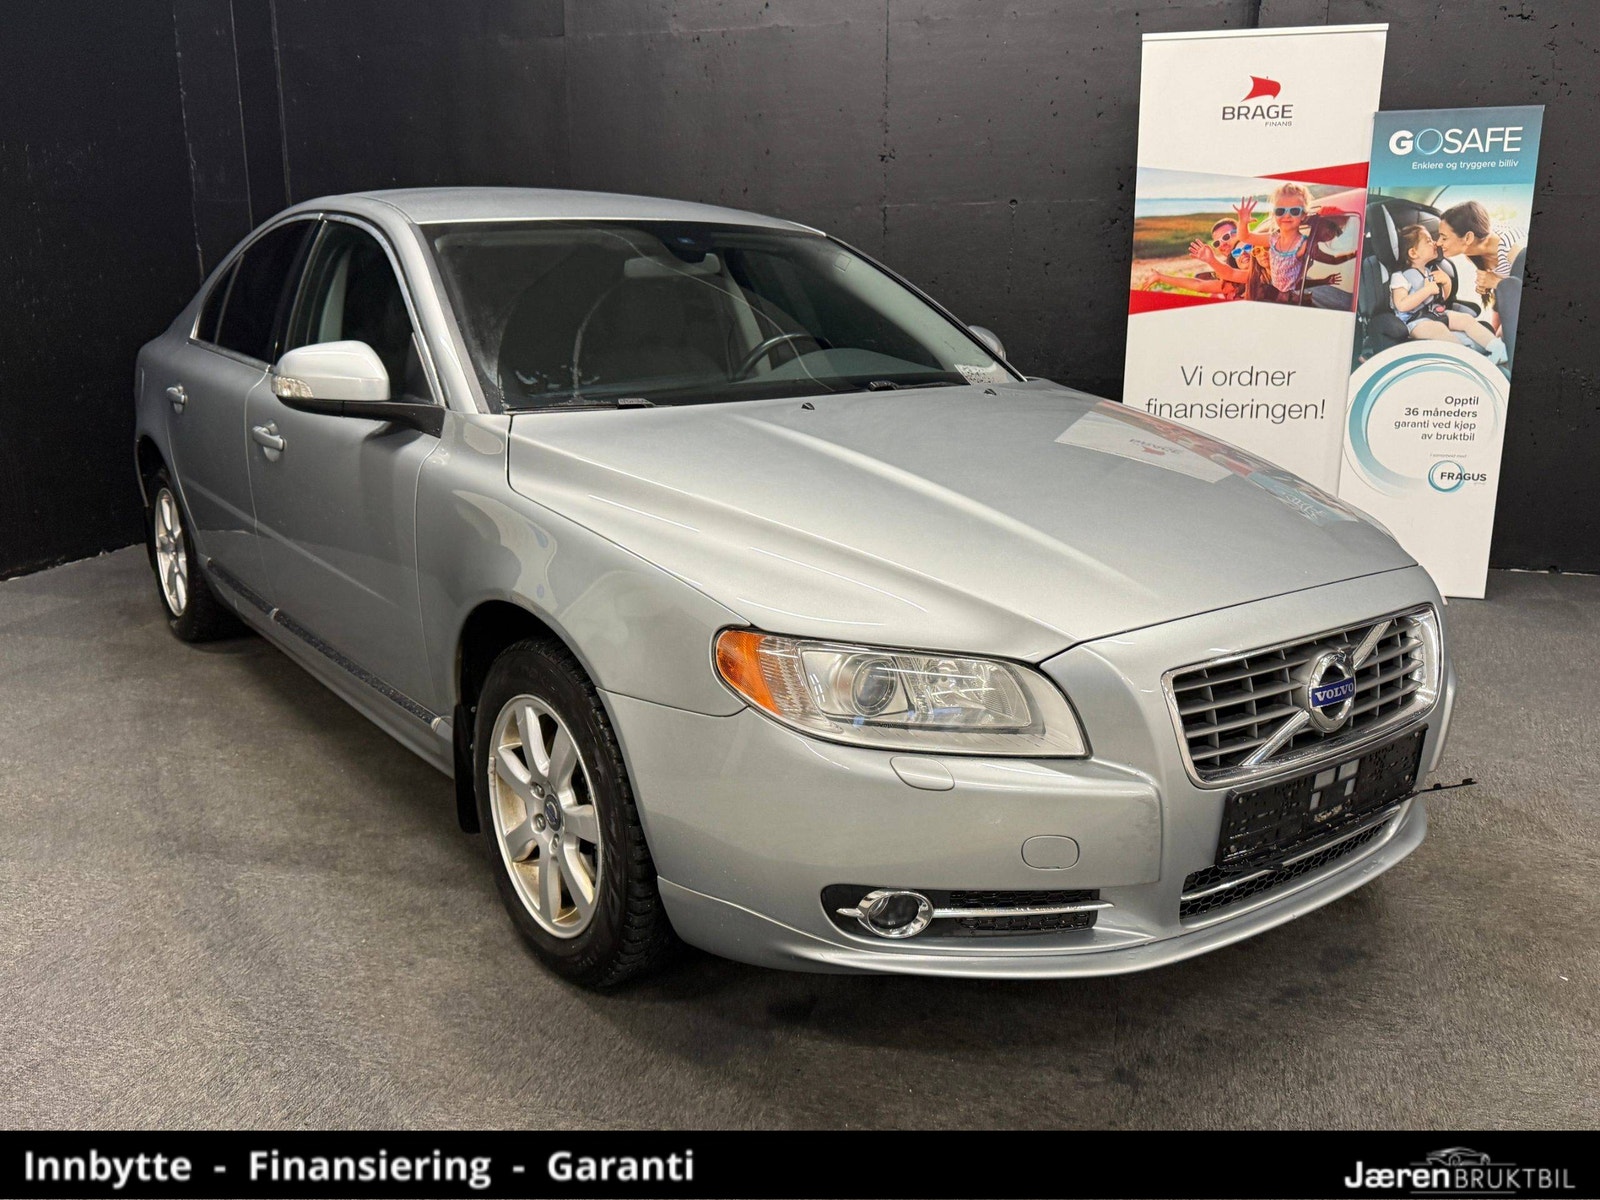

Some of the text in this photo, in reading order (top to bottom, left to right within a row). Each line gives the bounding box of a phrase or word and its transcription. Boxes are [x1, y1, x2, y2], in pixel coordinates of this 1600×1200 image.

[1222, 104, 1294, 120] BRAGE
[1388, 126, 1523, 156] GOSAFE
[1411, 159, 1519, 170] Enklere og tryggere billiv
[1180, 365, 1297, 387] Vi ordner
[1444, 395, 1480, 407] Opptil
[1145, 398, 1326, 425] finansieringen!
[1404, 407, 1478, 418] 36 måneders
[1394, 420, 1477, 431] garanti ved kjøp
[1421, 431, 1476, 441] av bruktbil
[1440, 471, 1487, 482] FRAGUS
[1315, 682, 1354, 702] VOLVO
